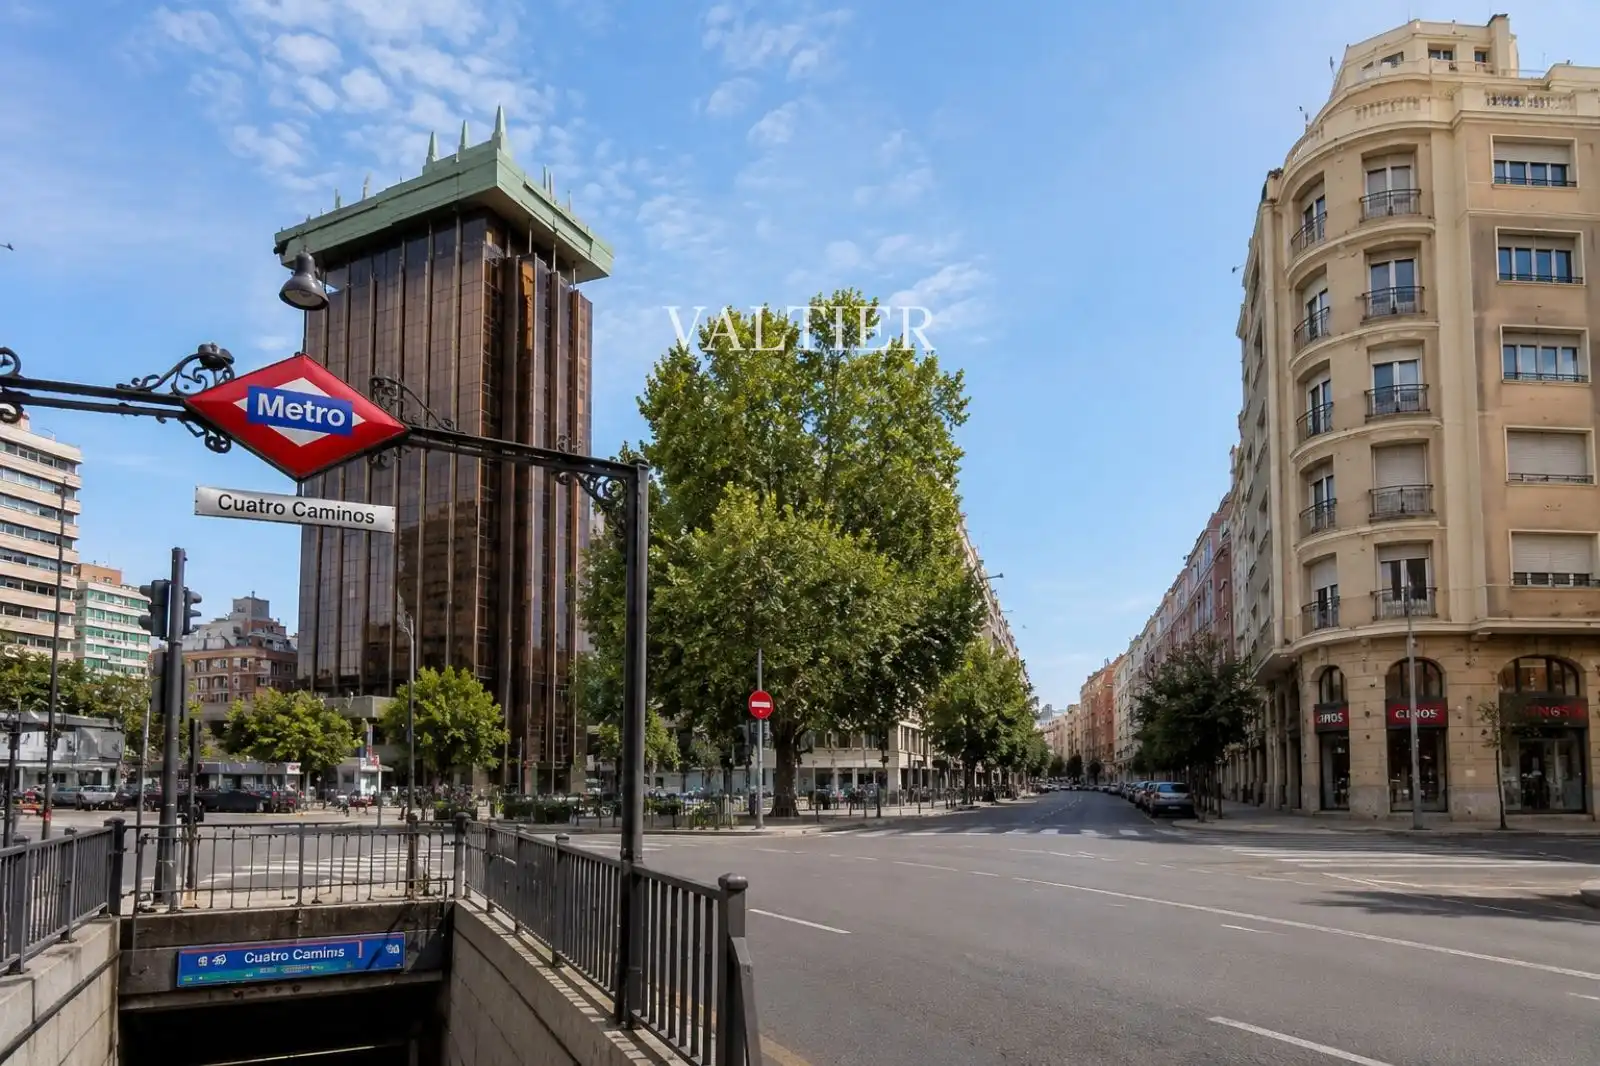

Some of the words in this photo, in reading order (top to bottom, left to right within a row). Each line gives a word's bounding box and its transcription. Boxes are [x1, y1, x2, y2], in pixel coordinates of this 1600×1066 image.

[257, 392, 346, 427] Metro
[218, 493, 286, 516] Cuatro
[292, 501, 376, 524] Caminos
[244, 951, 289, 964] Cuatro
